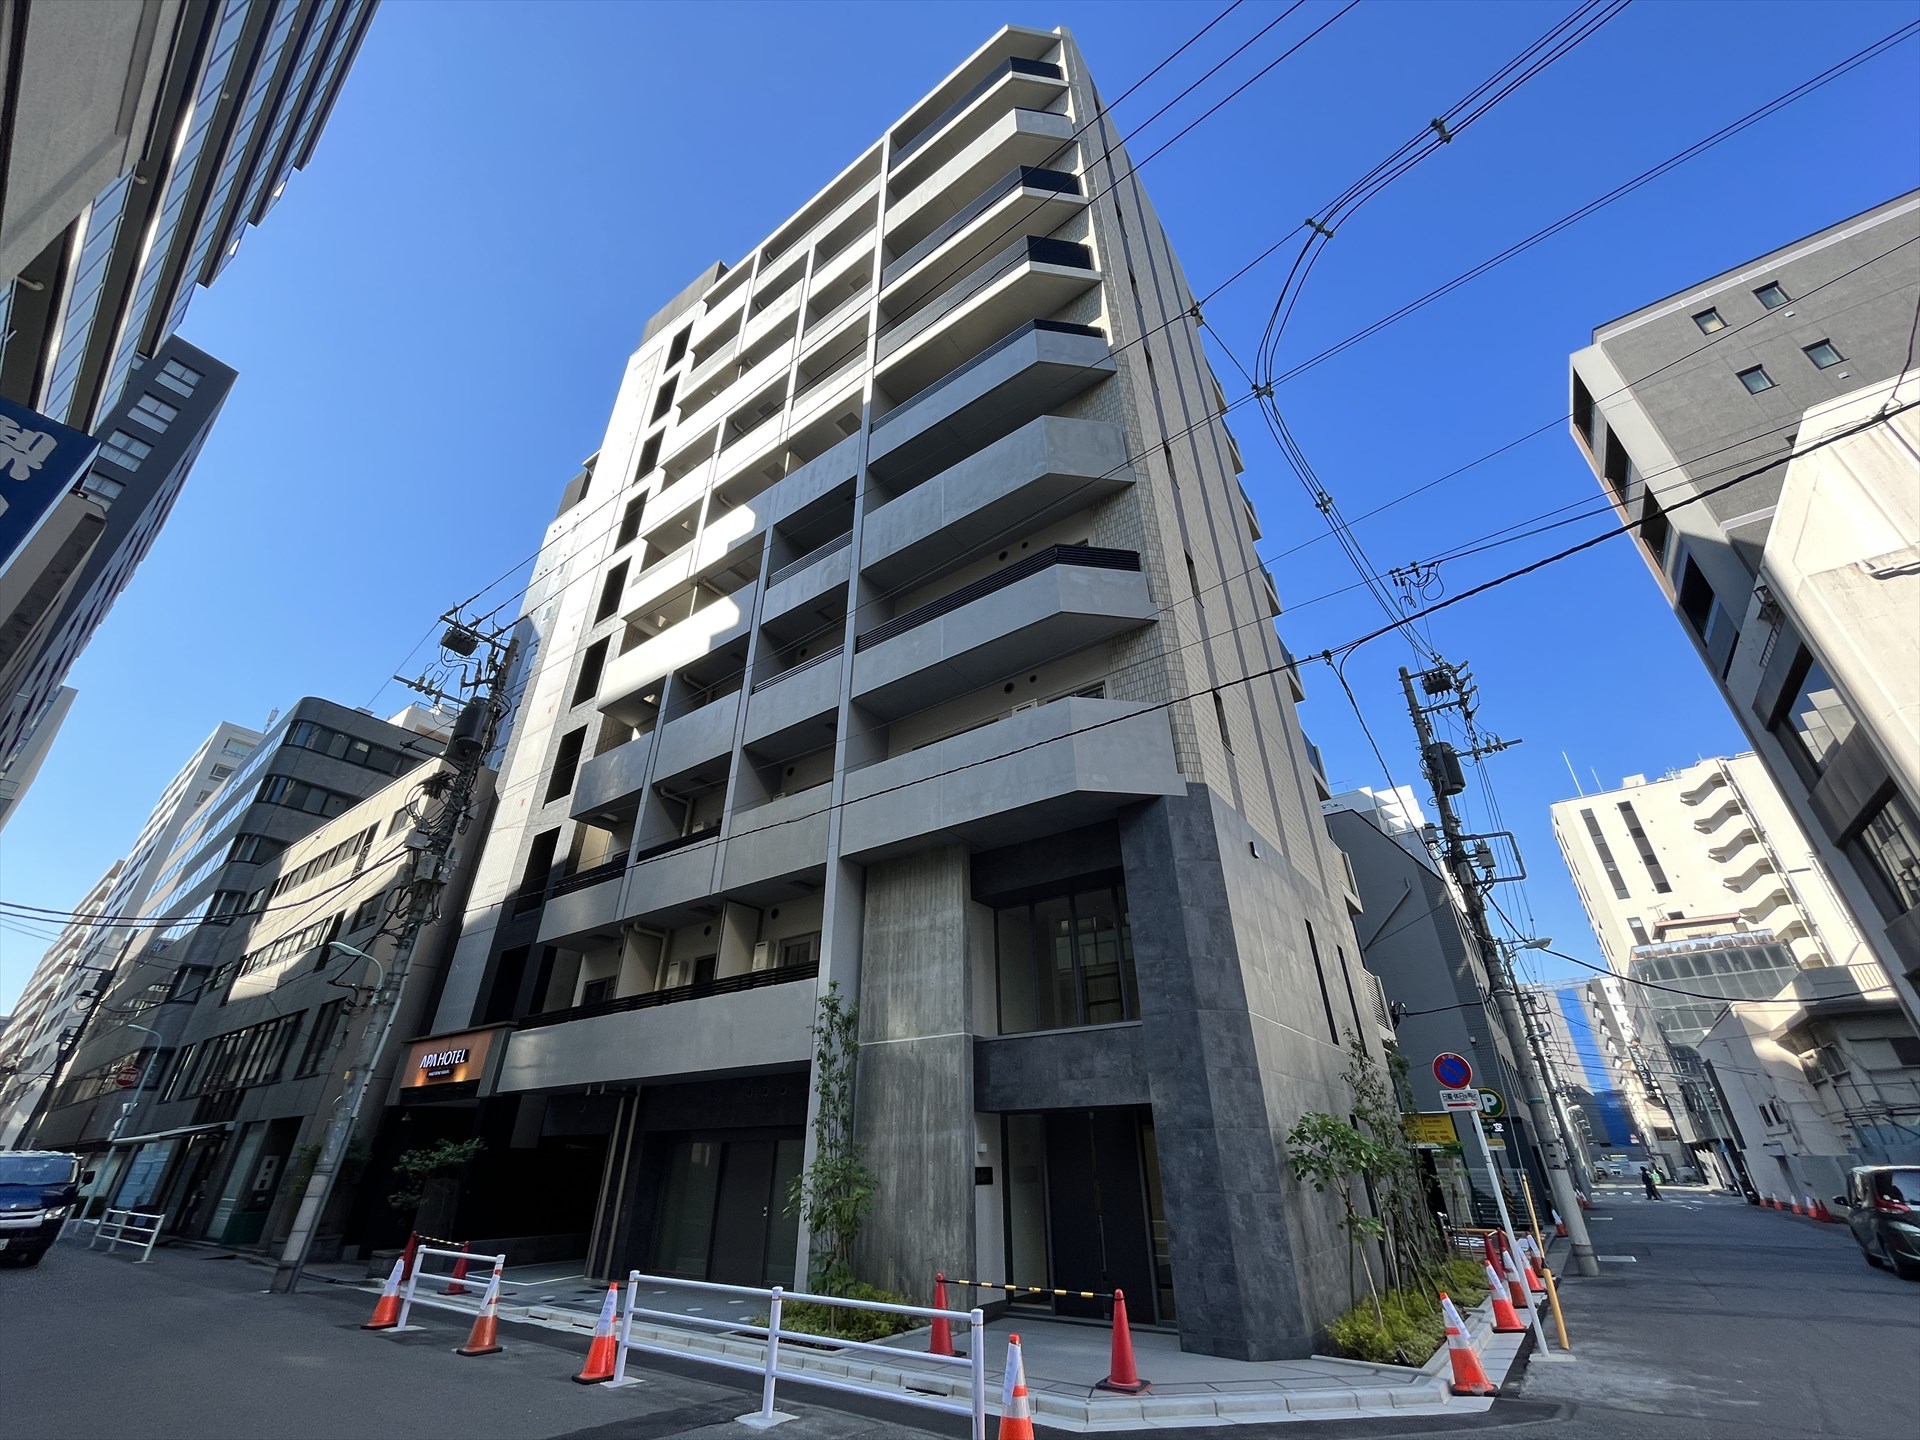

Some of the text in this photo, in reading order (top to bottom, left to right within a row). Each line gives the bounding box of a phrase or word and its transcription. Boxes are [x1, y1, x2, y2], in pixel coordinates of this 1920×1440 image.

[420, 1049, 466, 1068] APA HOTEL
[1481, 1094, 1498, 1112] P
